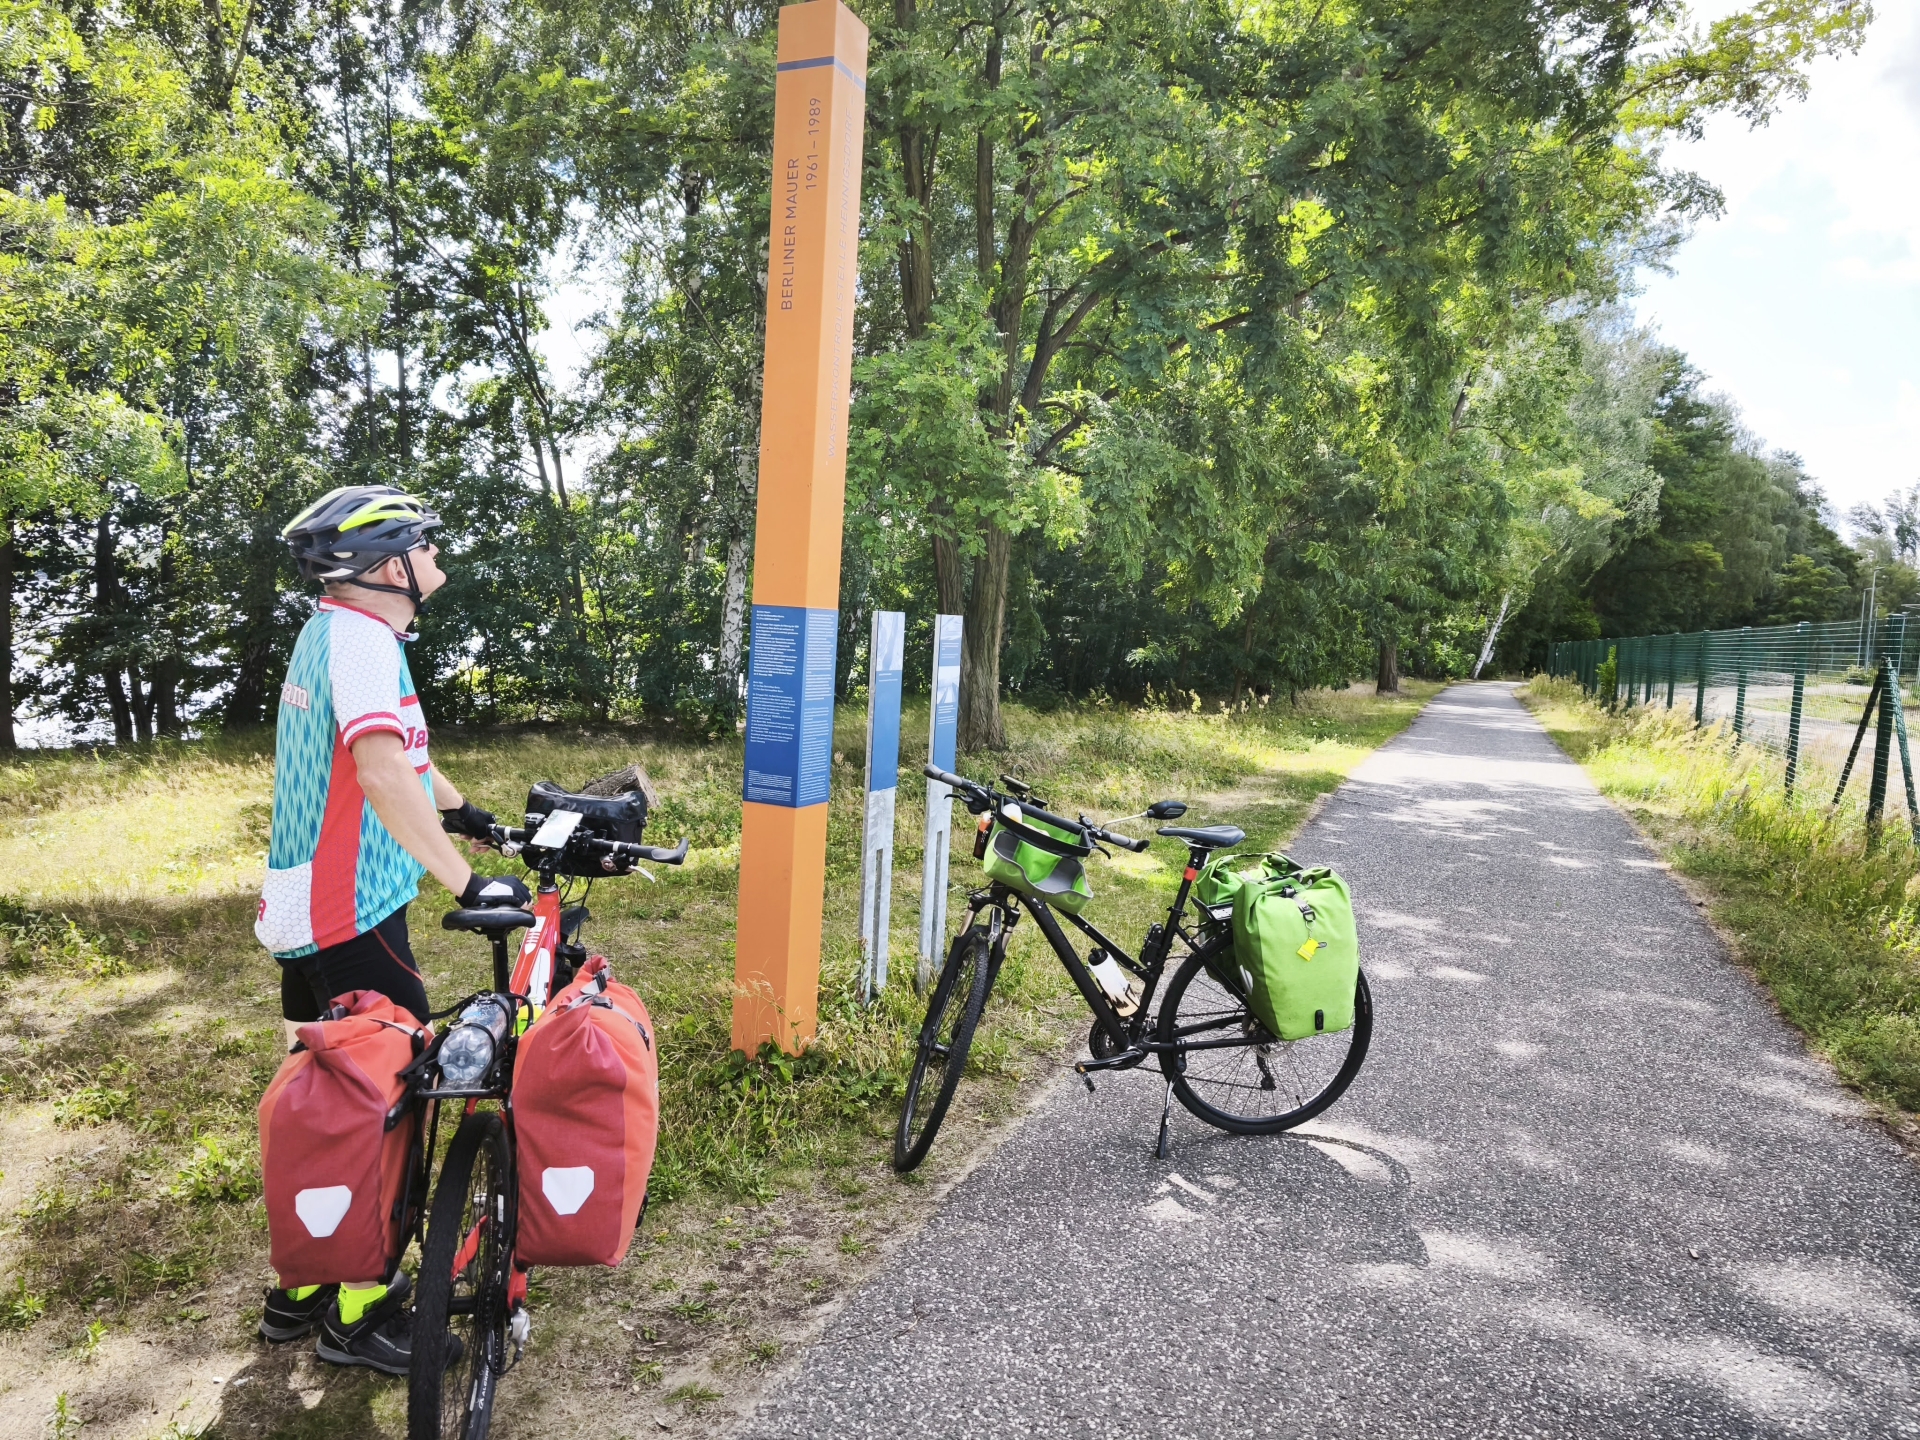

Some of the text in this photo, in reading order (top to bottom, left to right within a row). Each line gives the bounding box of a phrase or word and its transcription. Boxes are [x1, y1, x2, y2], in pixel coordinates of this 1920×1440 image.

[808, 97, 821, 136] 1989
[806, 154, 818, 190] 1961
[781, 157, 800, 311] BERLINER MAUER
[828, 238, 847, 458] WASSERKONTROLLSTELLE
[840, 107, 853, 234] HENNIGSDORF
